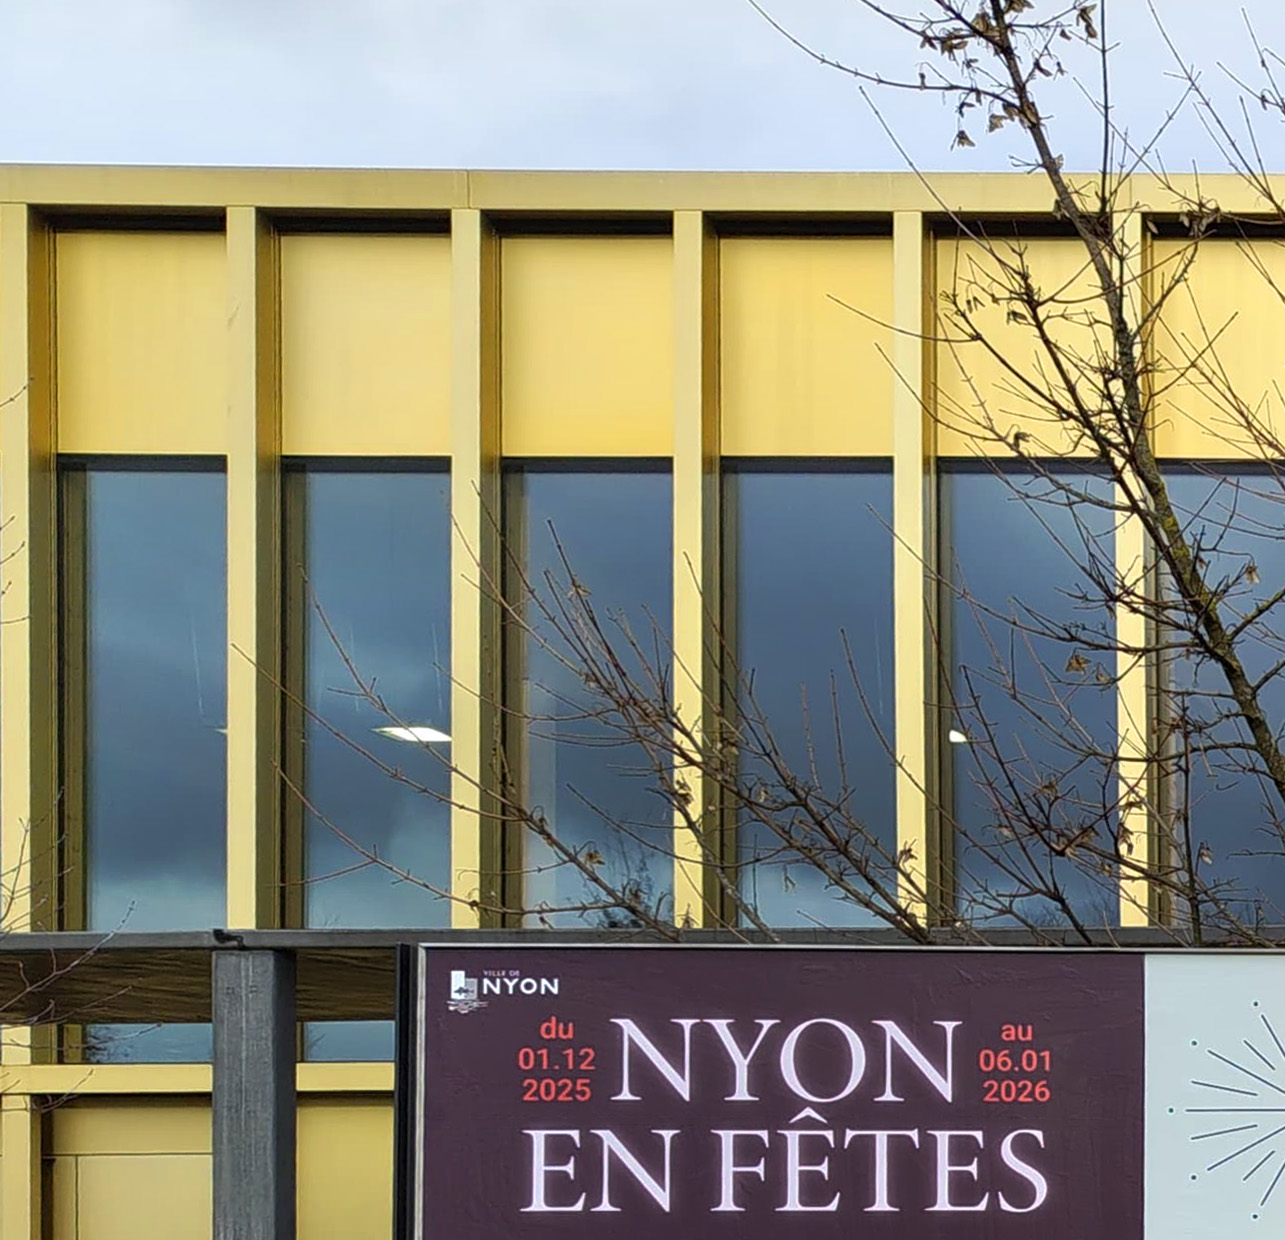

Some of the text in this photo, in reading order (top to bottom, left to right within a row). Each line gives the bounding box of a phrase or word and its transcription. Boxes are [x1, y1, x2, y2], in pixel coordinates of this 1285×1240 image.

[483, 978, 558, 994] NYON
[540, 1016, 573, 1039] du
[1002, 1025, 1032, 1041] au
[519, 1048, 595, 1069] 01.12
[610, 1018, 962, 1102] NYON
[980, 1050, 1049, 1071] 06.01
[523, 1079, 590, 1101] 2025
[984, 1080, 1050, 1102] 2026
[520, 1107, 1047, 1212] EN FÊTES
